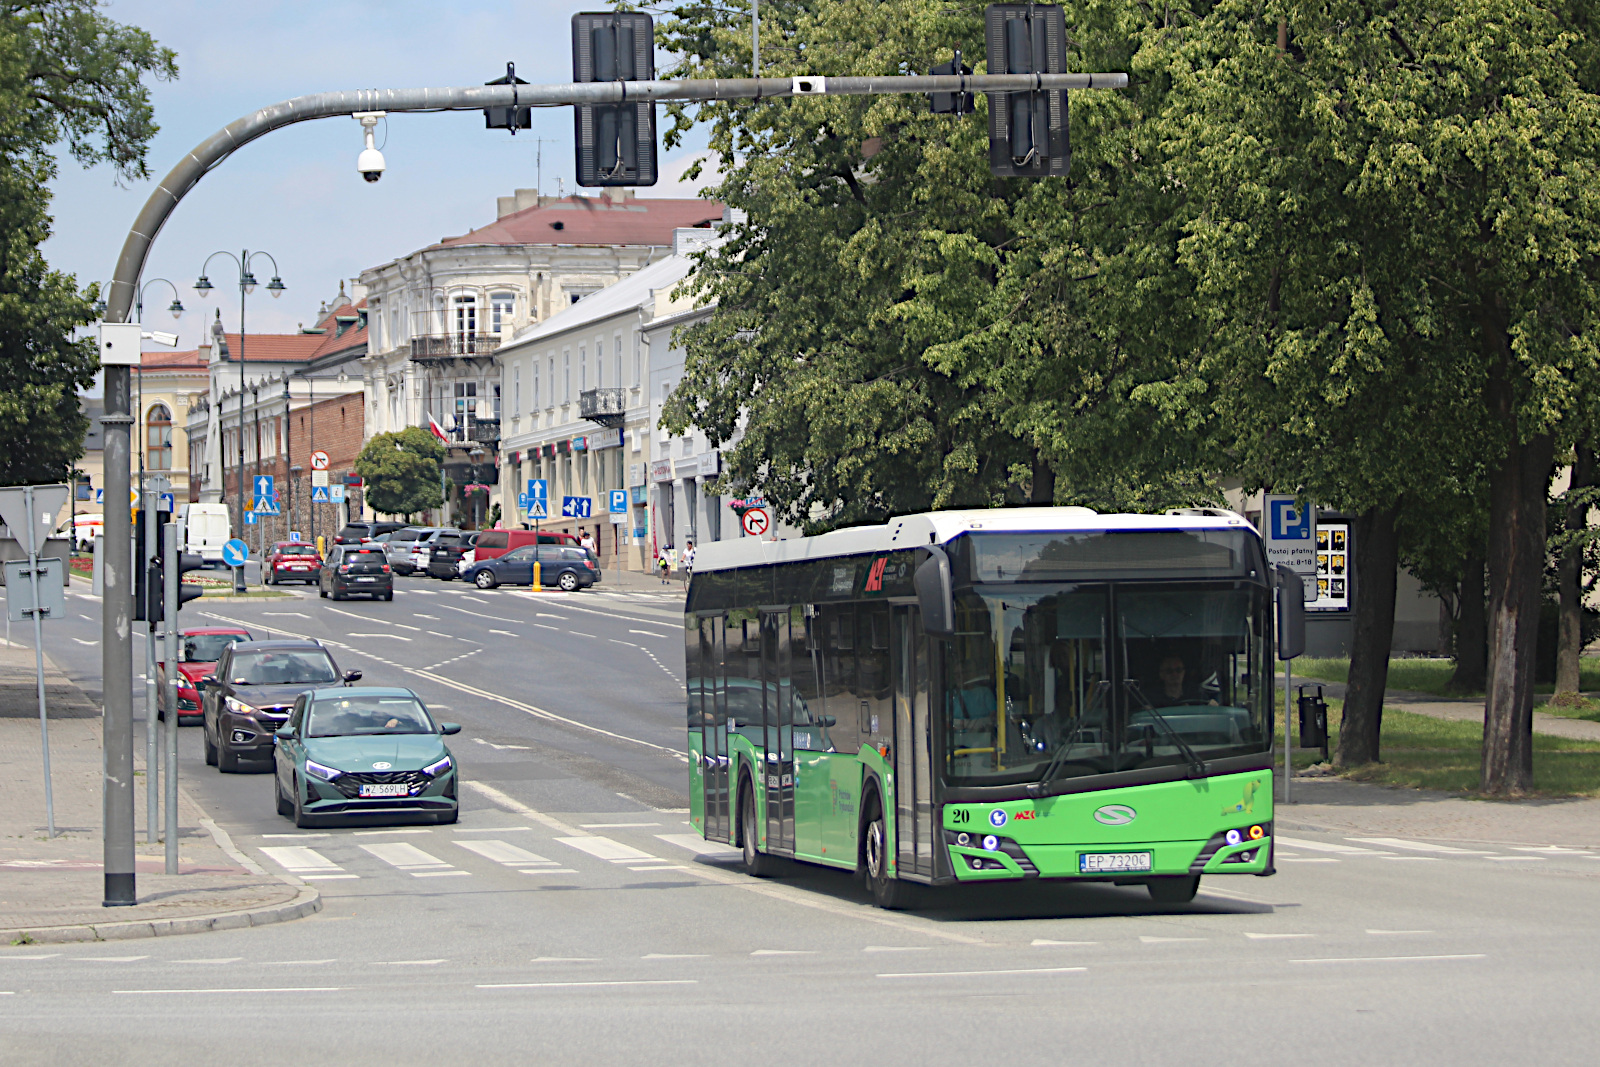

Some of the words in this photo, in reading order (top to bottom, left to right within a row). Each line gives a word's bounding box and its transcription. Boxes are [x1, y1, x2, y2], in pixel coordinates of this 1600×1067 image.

[612, 492, 624, 506] P
[1280, 504, 1302, 536] P
[365, 785, 376, 794] WZ
[380, 785, 406, 794] 569LH
[952, 808, 970, 823] 20
[1088, 855, 1104, 868] EP
